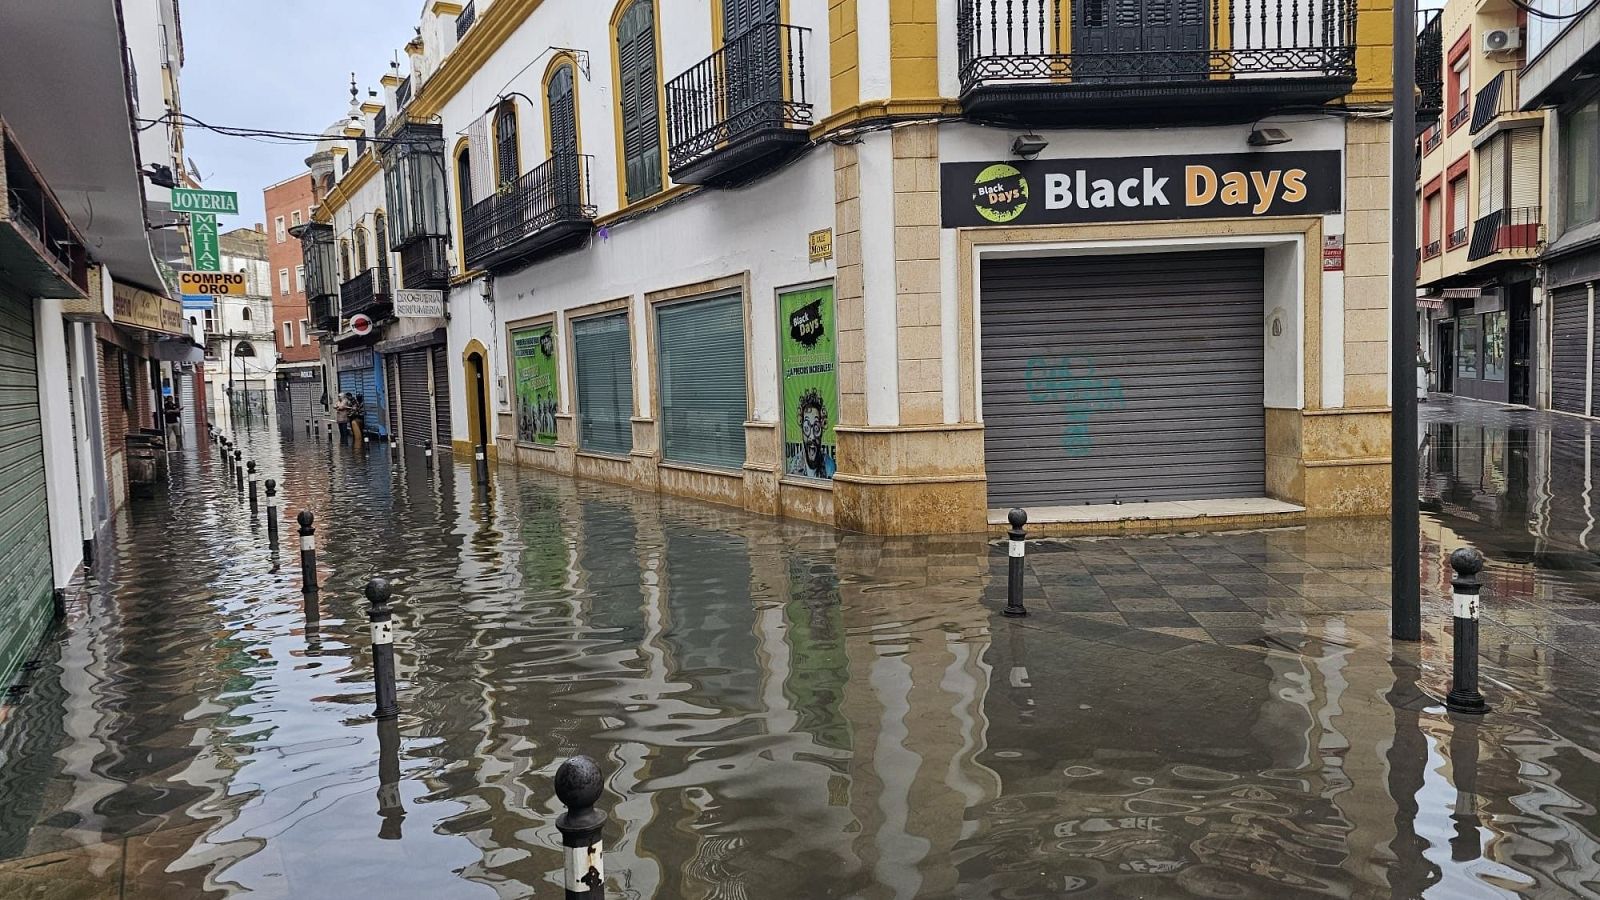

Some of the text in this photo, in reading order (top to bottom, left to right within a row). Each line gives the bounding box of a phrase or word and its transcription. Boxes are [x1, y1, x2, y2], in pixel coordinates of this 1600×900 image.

[978, 183, 1004, 196] Black
[988, 189, 1020, 204] Days
[1044, 165, 1308, 214] Black Days
[174, 192, 236, 210] JOYERIA
[195, 214, 216, 271] MATIAS
[181, 273, 243, 284] COMPRO
[198, 284, 229, 294] ORO
[793, 312, 809, 327] Black
[800, 319, 819, 336] Days
